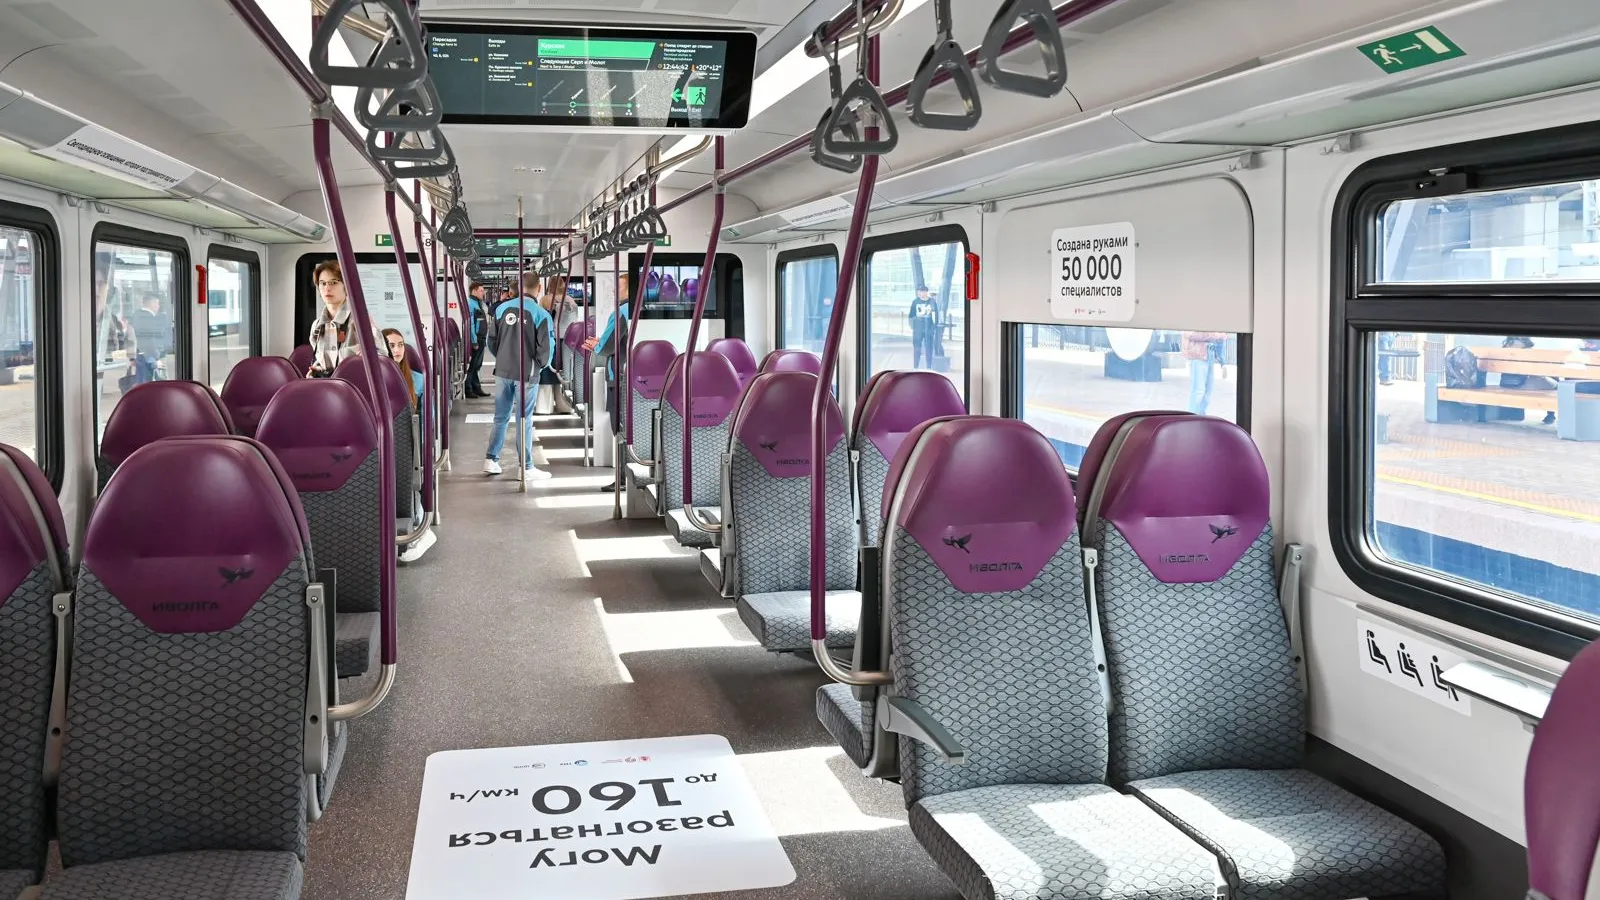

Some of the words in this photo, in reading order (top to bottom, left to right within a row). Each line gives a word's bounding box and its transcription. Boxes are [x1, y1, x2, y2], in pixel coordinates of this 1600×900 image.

[1056, 238, 1091, 252] Создана
[1093, 236, 1128, 252] руками
[1061, 256, 1082, 281] 50
[1086, 254, 1122, 281] 000
[1061, 286, 1122, 298] специалистов
[1159, 554, 1210, 563] ИВОЛГА
[969, 562, 1023, 572] ИВОЛГА
[151, 601, 219, 612] ИВОЛГА
[685, 773, 717, 783] до
[450, 788, 519, 802] км/ч
[531, 777, 682, 815] 160
[448, 810, 735, 848] разогнаться
[529, 844, 662, 868] Могу
